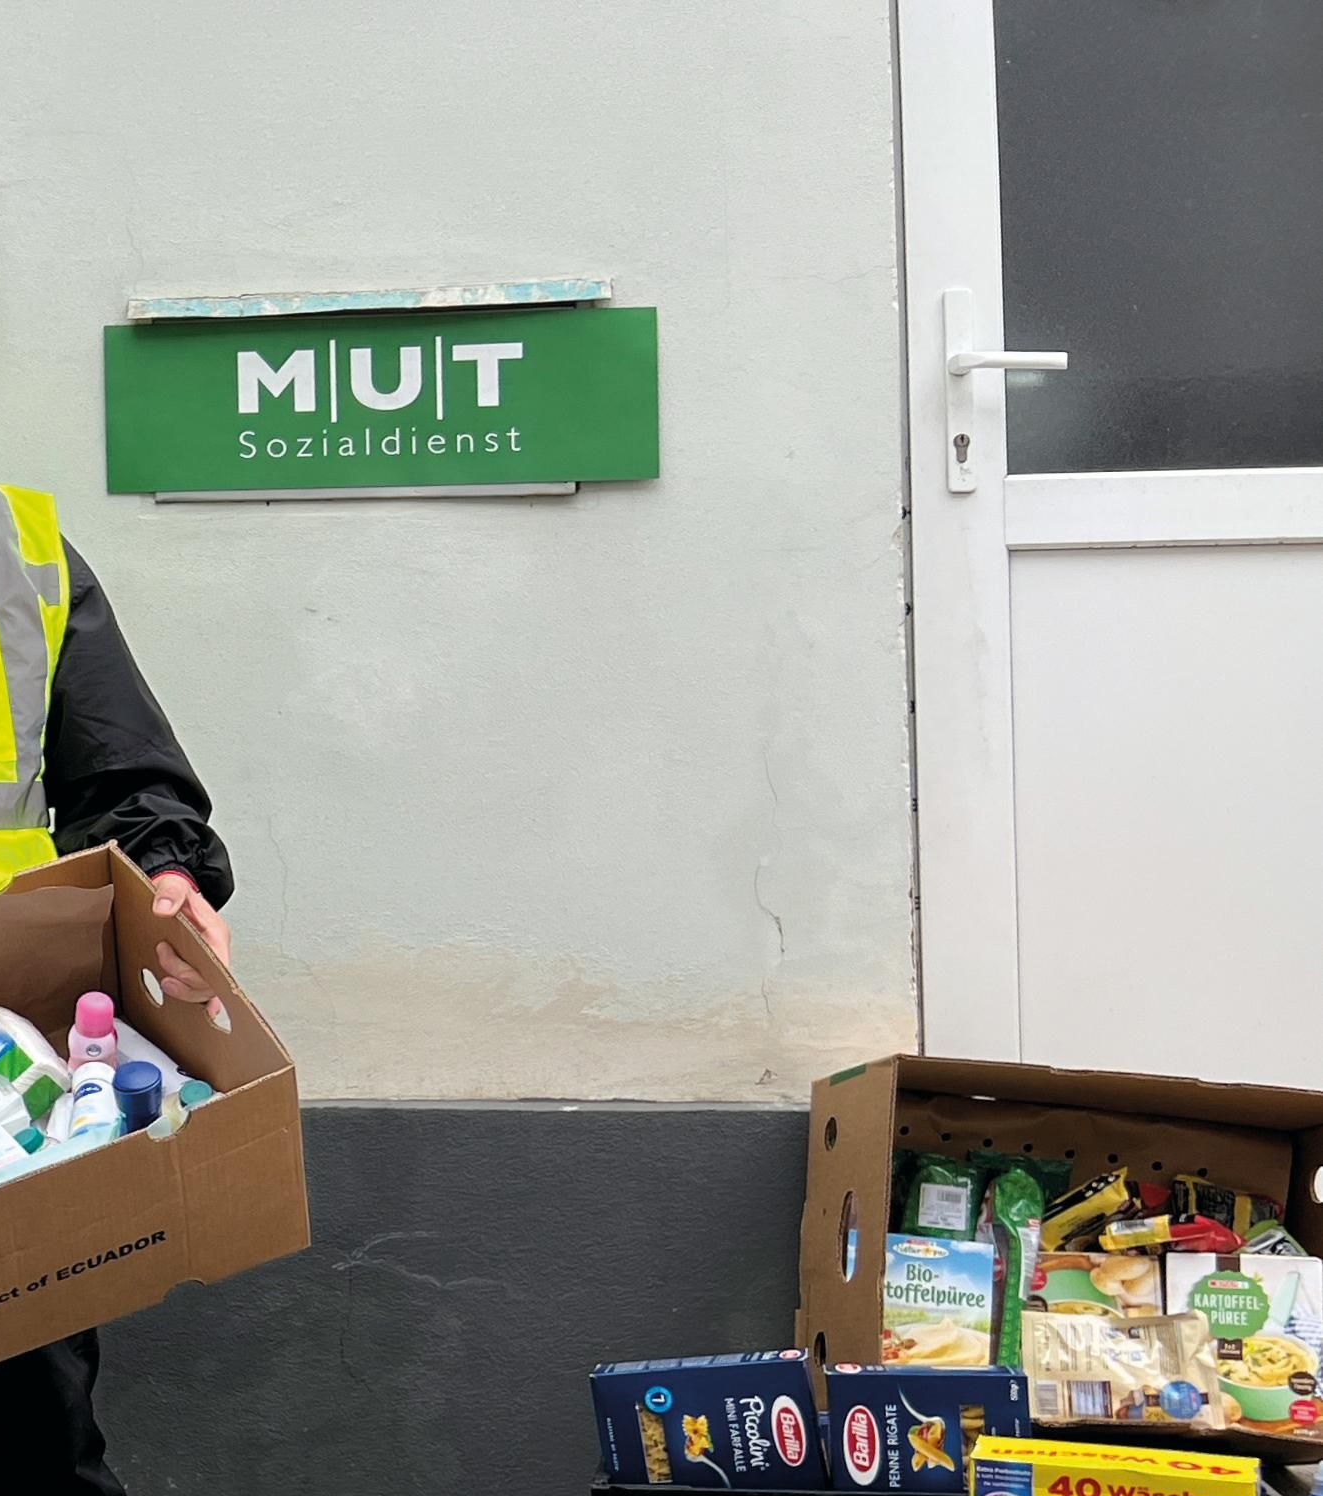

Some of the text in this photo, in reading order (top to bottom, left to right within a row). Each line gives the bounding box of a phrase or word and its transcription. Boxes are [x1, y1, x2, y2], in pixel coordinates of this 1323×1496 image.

[238, 426, 523, 459] Sozialdienst
[26, 1274, 51, 1295] of
[55, 1230, 168, 1283] ECUADOR
[906, 1264, 940, 1283] Bio-
[1194, 1292, 1265, 1311] KARTOFFEL-
[1210, 1308, 1249, 1326] PÜREE
[724, 1397, 747, 1473] MINI FARFALLE
[739, 1396, 765, 1471] Piccolini
[776, 1411, 805, 1462] Barilla
[852, 1414, 871, 1475] Barilla
[887, 1404, 900, 1488] PENNE RIGATE
